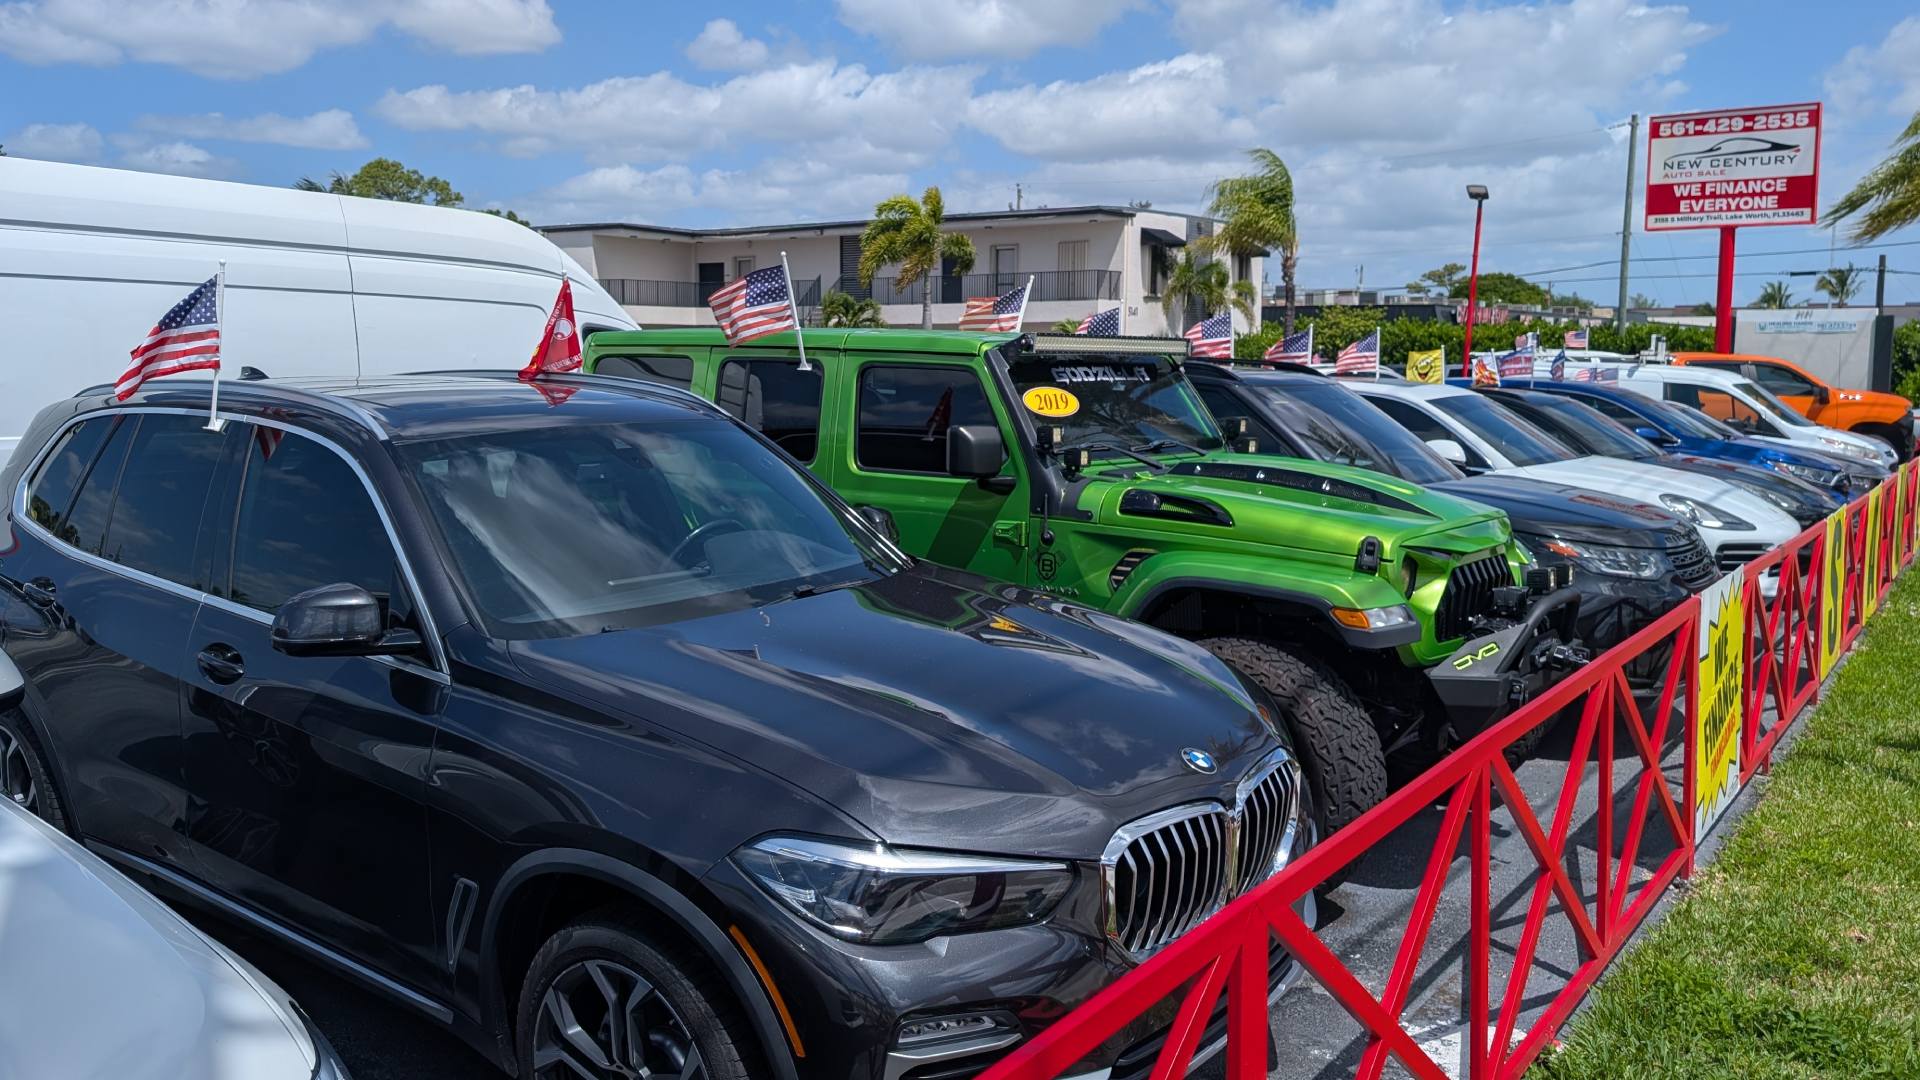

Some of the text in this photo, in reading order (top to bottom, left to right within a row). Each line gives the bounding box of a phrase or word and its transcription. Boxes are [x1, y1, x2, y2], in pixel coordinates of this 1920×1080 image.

[1658, 112, 1809, 137] 561-429-2535
[1663, 154, 1798, 171] NEW CENTURY
[1662, 169, 1726, 179] AUTO SALE
[1673, 178, 1788, 197] WE FINANCE
[1679, 195, 1779, 213] EVERYONE
[1677, 215, 1704, 223] Military
[1725, 212, 1743, 220] Lake
[1051, 366, 1151, 384] GODZILLA
[1034, 393, 1069, 411] 2019
[1714, 621, 1729, 685] WE
[1703, 649, 1739, 768] FINANCE
